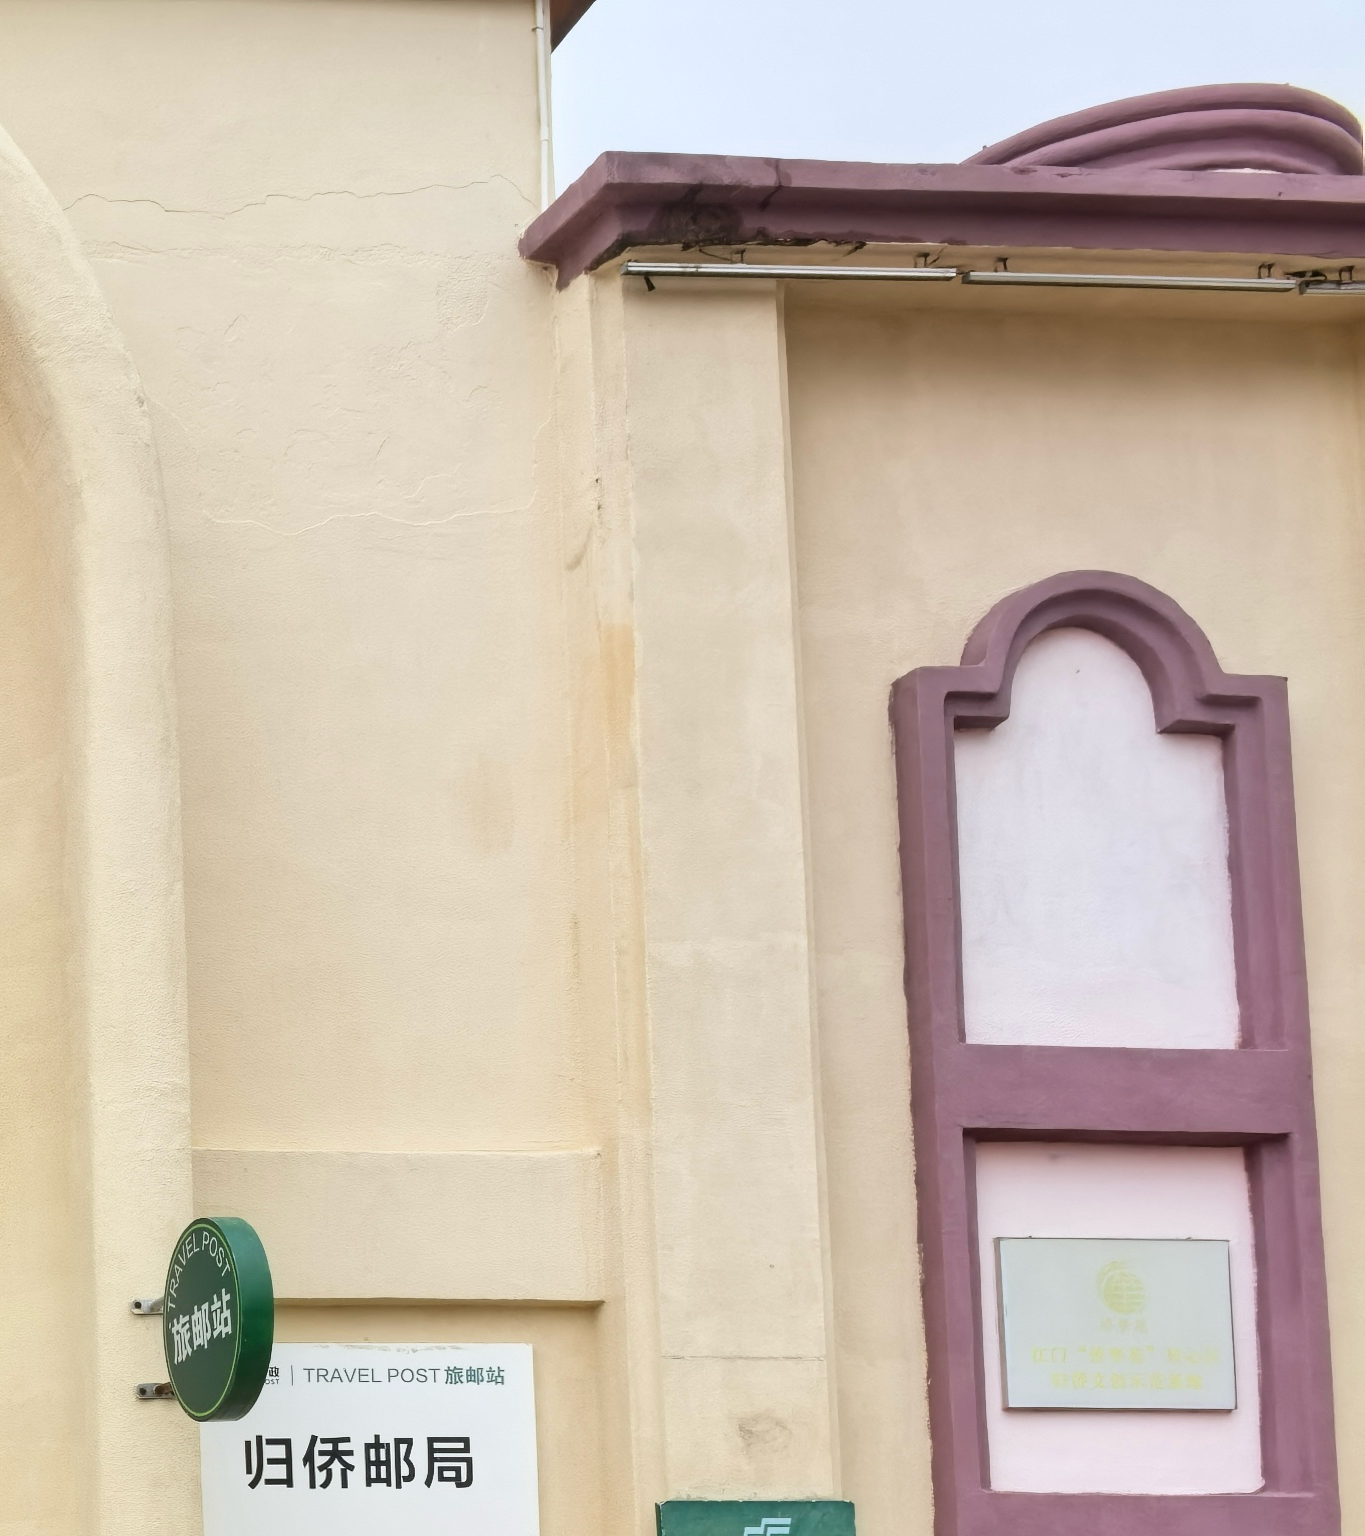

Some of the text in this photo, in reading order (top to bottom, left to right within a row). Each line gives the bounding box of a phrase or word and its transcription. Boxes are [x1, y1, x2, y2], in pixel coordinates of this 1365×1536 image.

[168, 1231, 231, 1312] TRAVEL POST
[169, 1288, 232, 1365] 旅邮站
[303, 1366, 505, 1385] TRAVEL POST 旅邮站
[244, 1434, 474, 1489] 归侨邮局
